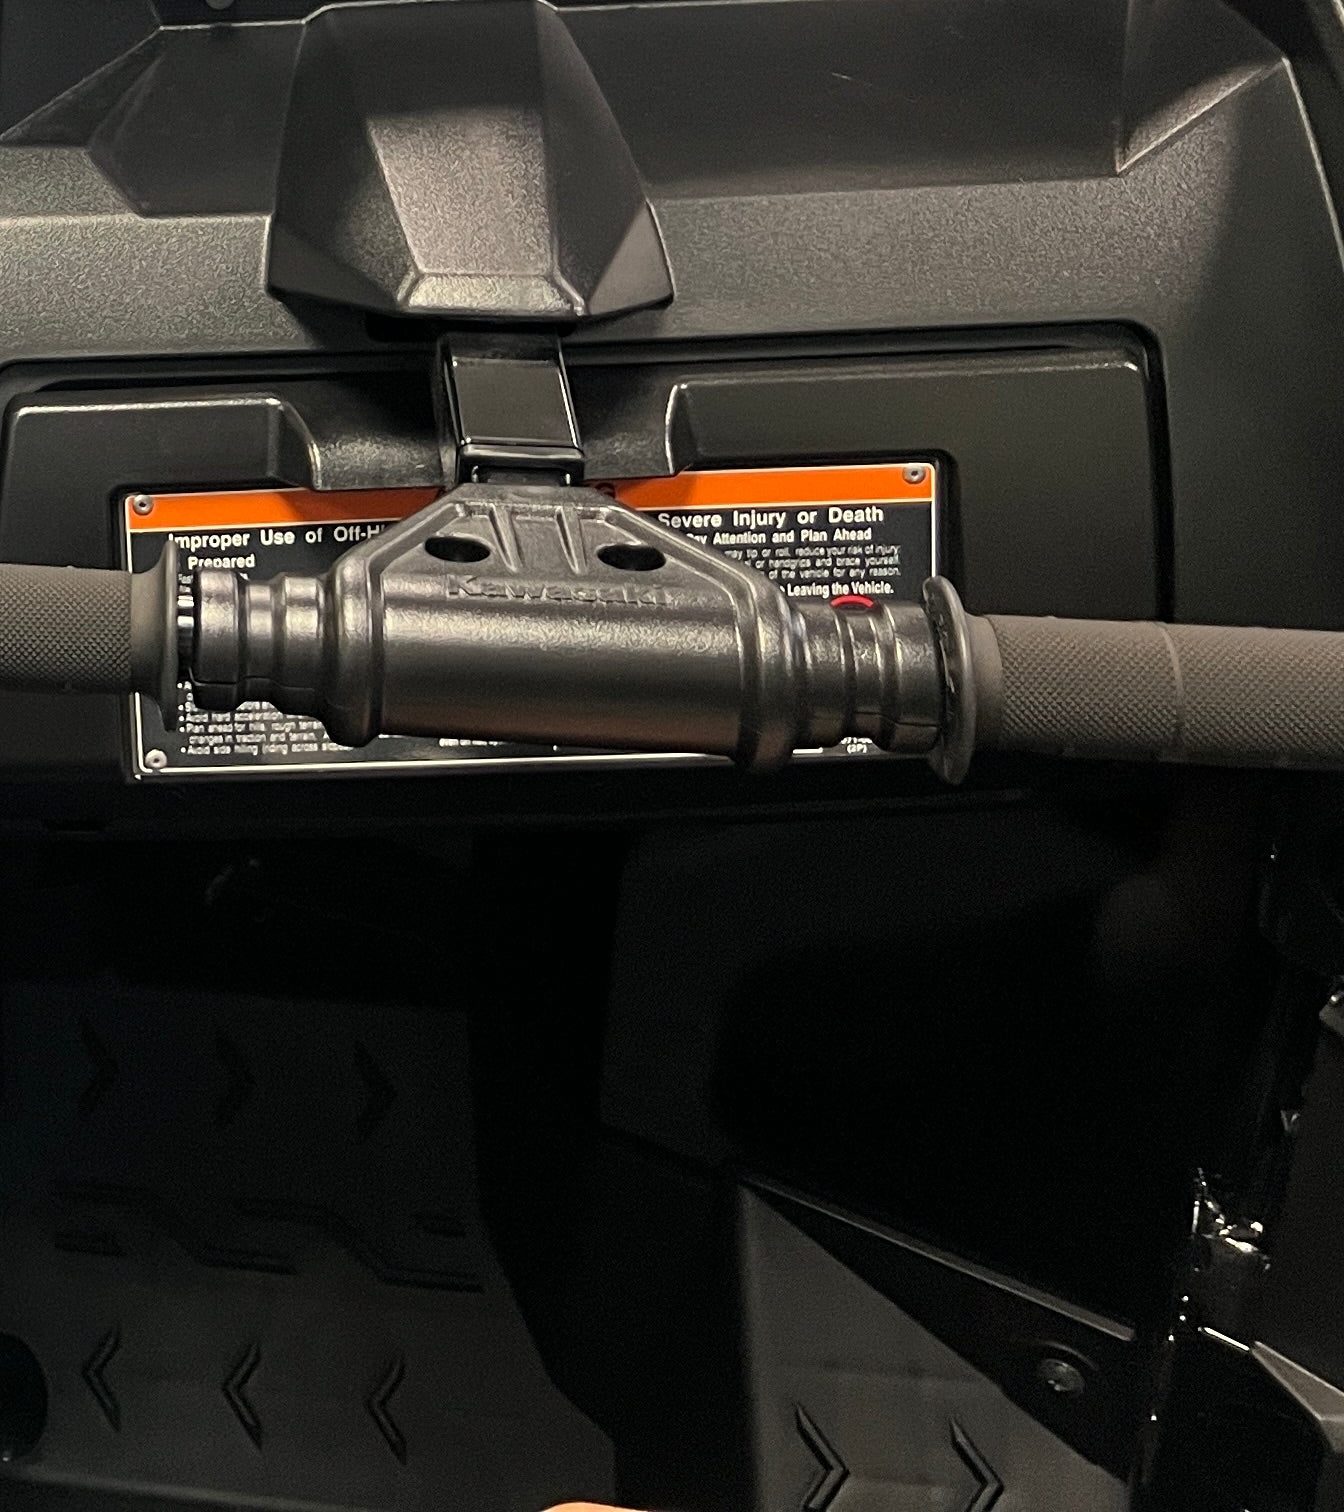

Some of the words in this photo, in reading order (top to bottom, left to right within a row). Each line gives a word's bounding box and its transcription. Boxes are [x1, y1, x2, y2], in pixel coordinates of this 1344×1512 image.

[658, 512, 722, 528] Severe
[733, 509, 786, 529] Injury
[797, 510, 817, 524] or
[828, 505, 884, 523] Death
[260, 528, 295, 546] Use
[305, 527, 322, 544] of
[713, 531, 766, 544] Attention
[771, 529, 795, 543] and
[800, 528, 827, 542] Plan
[833, 527, 871, 541] Ahead
[188, 554, 255, 570] Prepared
[787, 582, 830, 599] Leaving
[831, 581, 850, 596] the
[851, 580, 894, 595] Vehicle.
